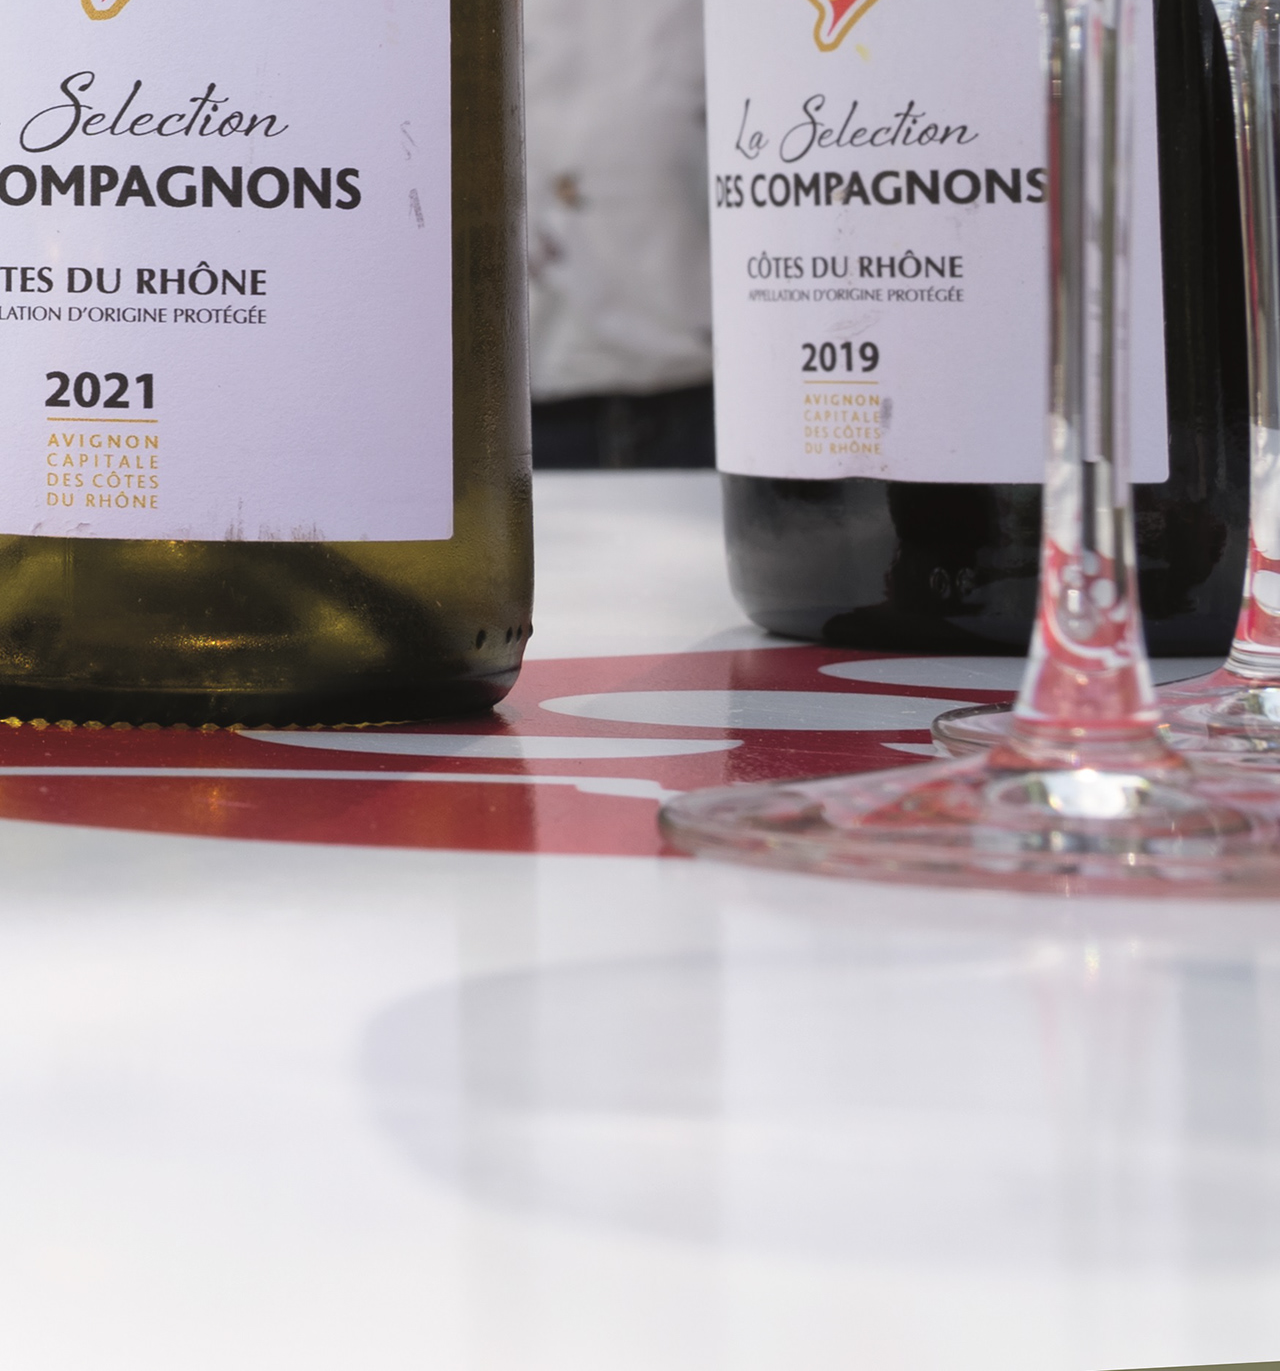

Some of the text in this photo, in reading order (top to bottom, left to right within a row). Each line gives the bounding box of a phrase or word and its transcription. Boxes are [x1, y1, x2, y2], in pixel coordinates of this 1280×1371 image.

[19, 70, 290, 154] Selection
[734, 93, 980, 164] La Selection
[715, 167, 1049, 209] DES COMPAGNONS
[747, 249, 964, 280] CÔTES DU RHÔNE
[66, 267, 122, 295] DU
[136, 260, 267, 296] RHÔNE
[748, 285, 964, 303] APPELLATION D'ORIGINE PROTÉGÉE
[68, 306, 168, 323] D'ORIGINE
[173, 304, 267, 325] PROTÉGÉE
[801, 341, 880, 373] 2019
[45, 370, 154, 409] 2021
[803, 393, 881, 407] AVIGNON
[803, 409, 881, 424] CAPITALE
[47, 432, 159, 450] AVIGNON
[804, 424, 881, 440] DES CÔTES
[804, 440, 882, 456] DU RHÔNE
[46, 452, 159, 470] CAPITALE
[46, 470, 160, 490] DES CÔTES
[46, 490, 159, 510] DU RHÔNE
